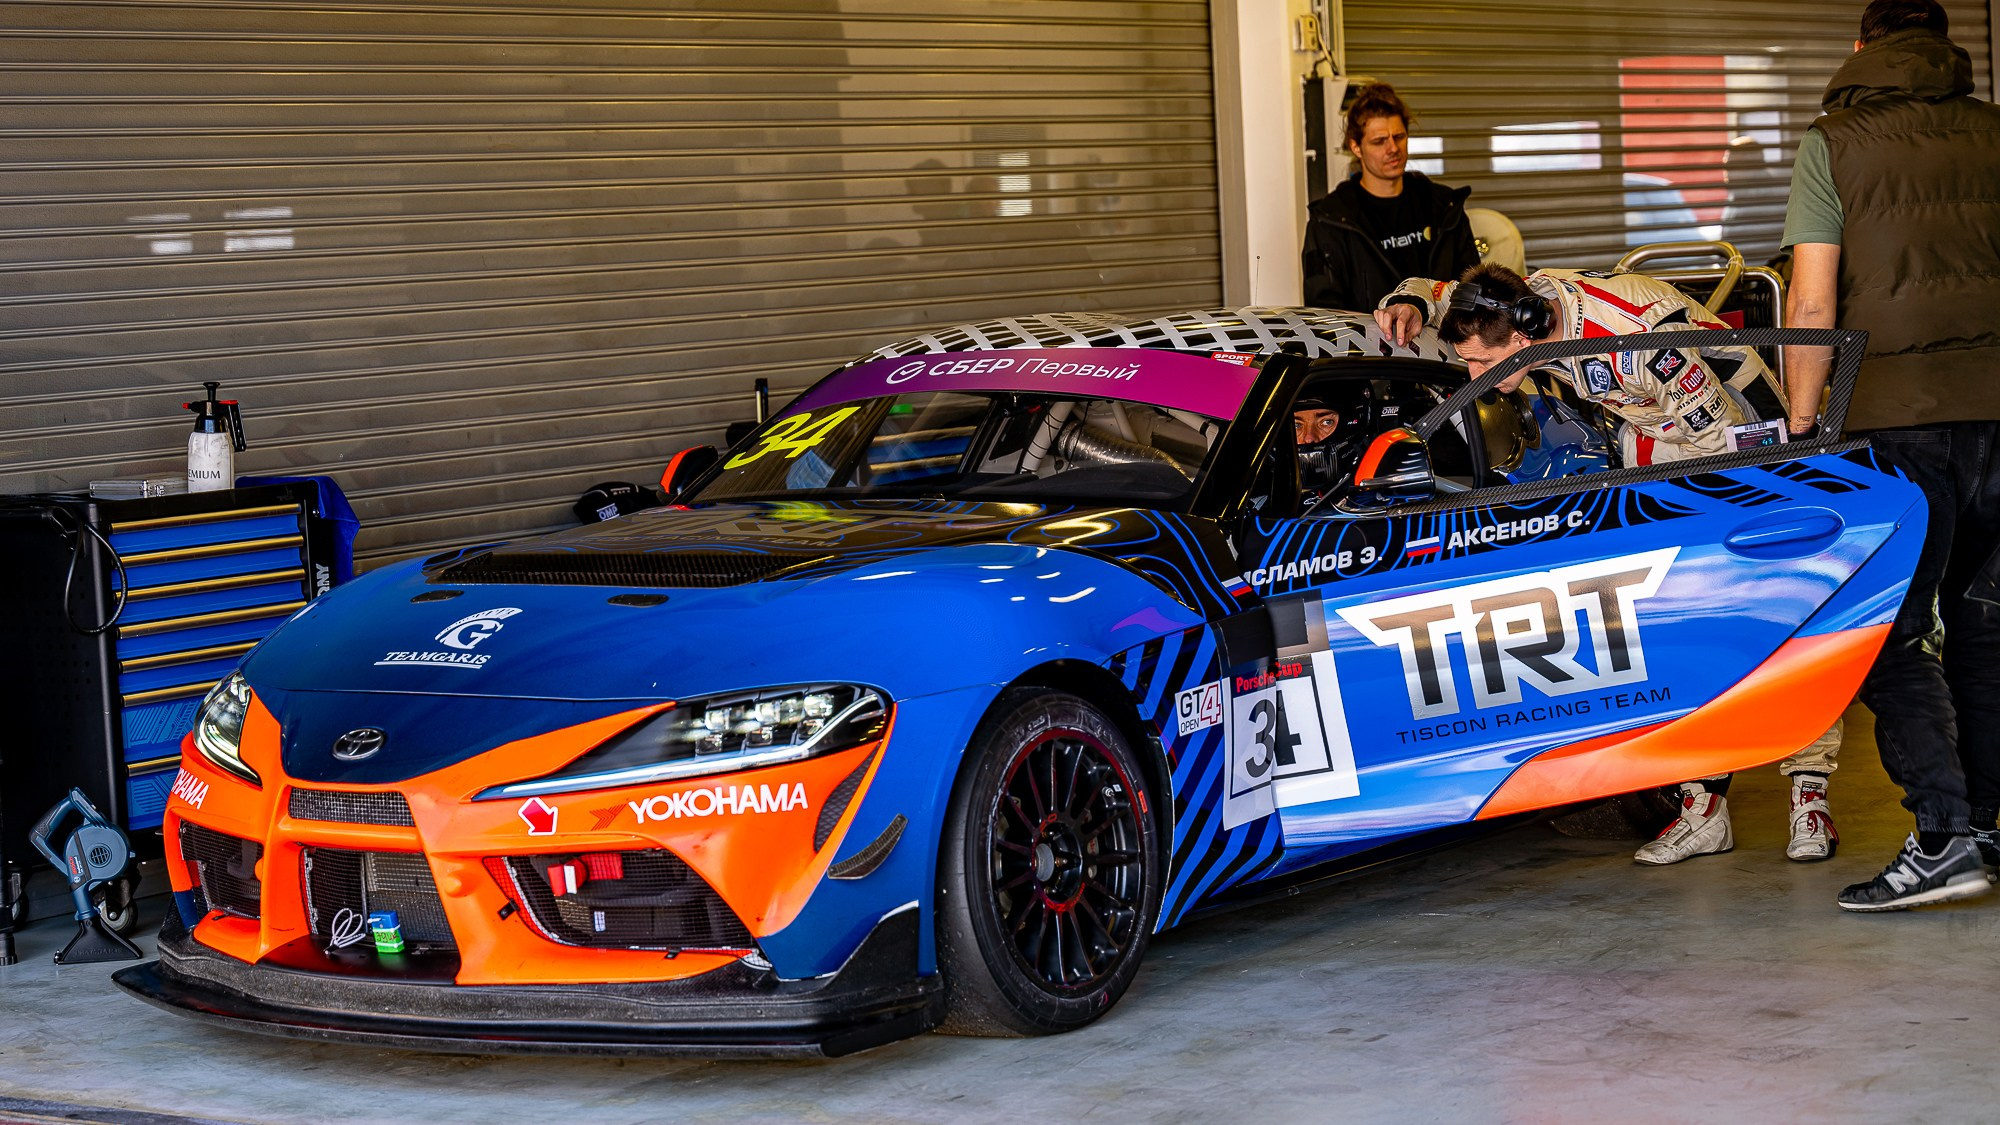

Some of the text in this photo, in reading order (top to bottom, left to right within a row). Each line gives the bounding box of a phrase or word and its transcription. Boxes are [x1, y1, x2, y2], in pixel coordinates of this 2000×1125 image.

[1213, 353, 1252, 361] SPORT
[928, 358, 1141, 382] СБЕР Первый
[1381, 406, 1399, 415] OMP
[723, 406, 861, 470] 34
[598, 505, 618, 520] OMP
[1447, 510, 1591, 551] АКСЕНОВ С.
[1359, 547, 1383, 564] Э.
[1335, 546, 1682, 720] TRT
[383, 651, 492, 665] TEAMGARIS
[1236, 671, 1275, 693] Porsche
[1180, 684, 1222, 725] GT4
[1396, 687, 1672, 745] TISCON RACING TEAM
[1180, 720, 1200, 734] OPEN
[628, 783, 809, 825] YOKOHAMA
